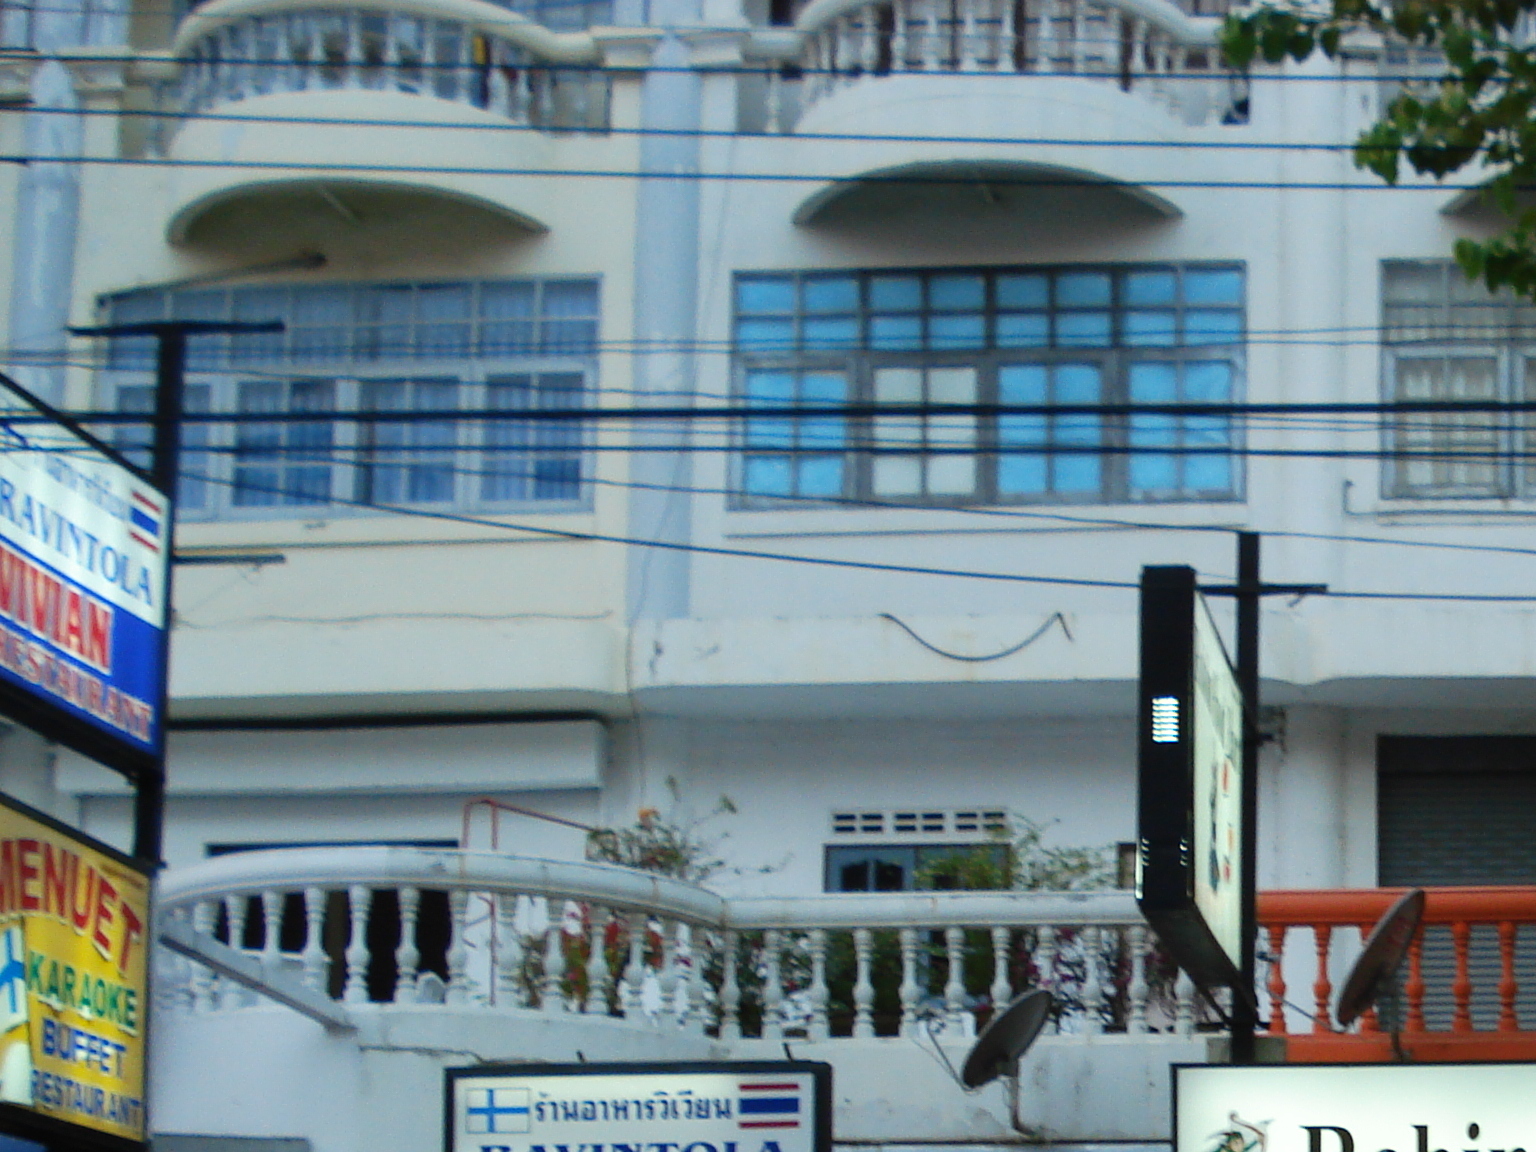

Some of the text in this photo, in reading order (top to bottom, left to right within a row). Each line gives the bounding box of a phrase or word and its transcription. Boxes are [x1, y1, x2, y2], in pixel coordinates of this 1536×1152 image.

[0, 477, 153, 607] RAVINTOLA
[28, 950, 137, 1029] KARAOKE
[43, 1017, 127, 1077] BUFFET
[32, 1069, 143, 1128] RESTAURANT
[534, 1090, 732, 1122] ร้านอาหารวิเวียน
